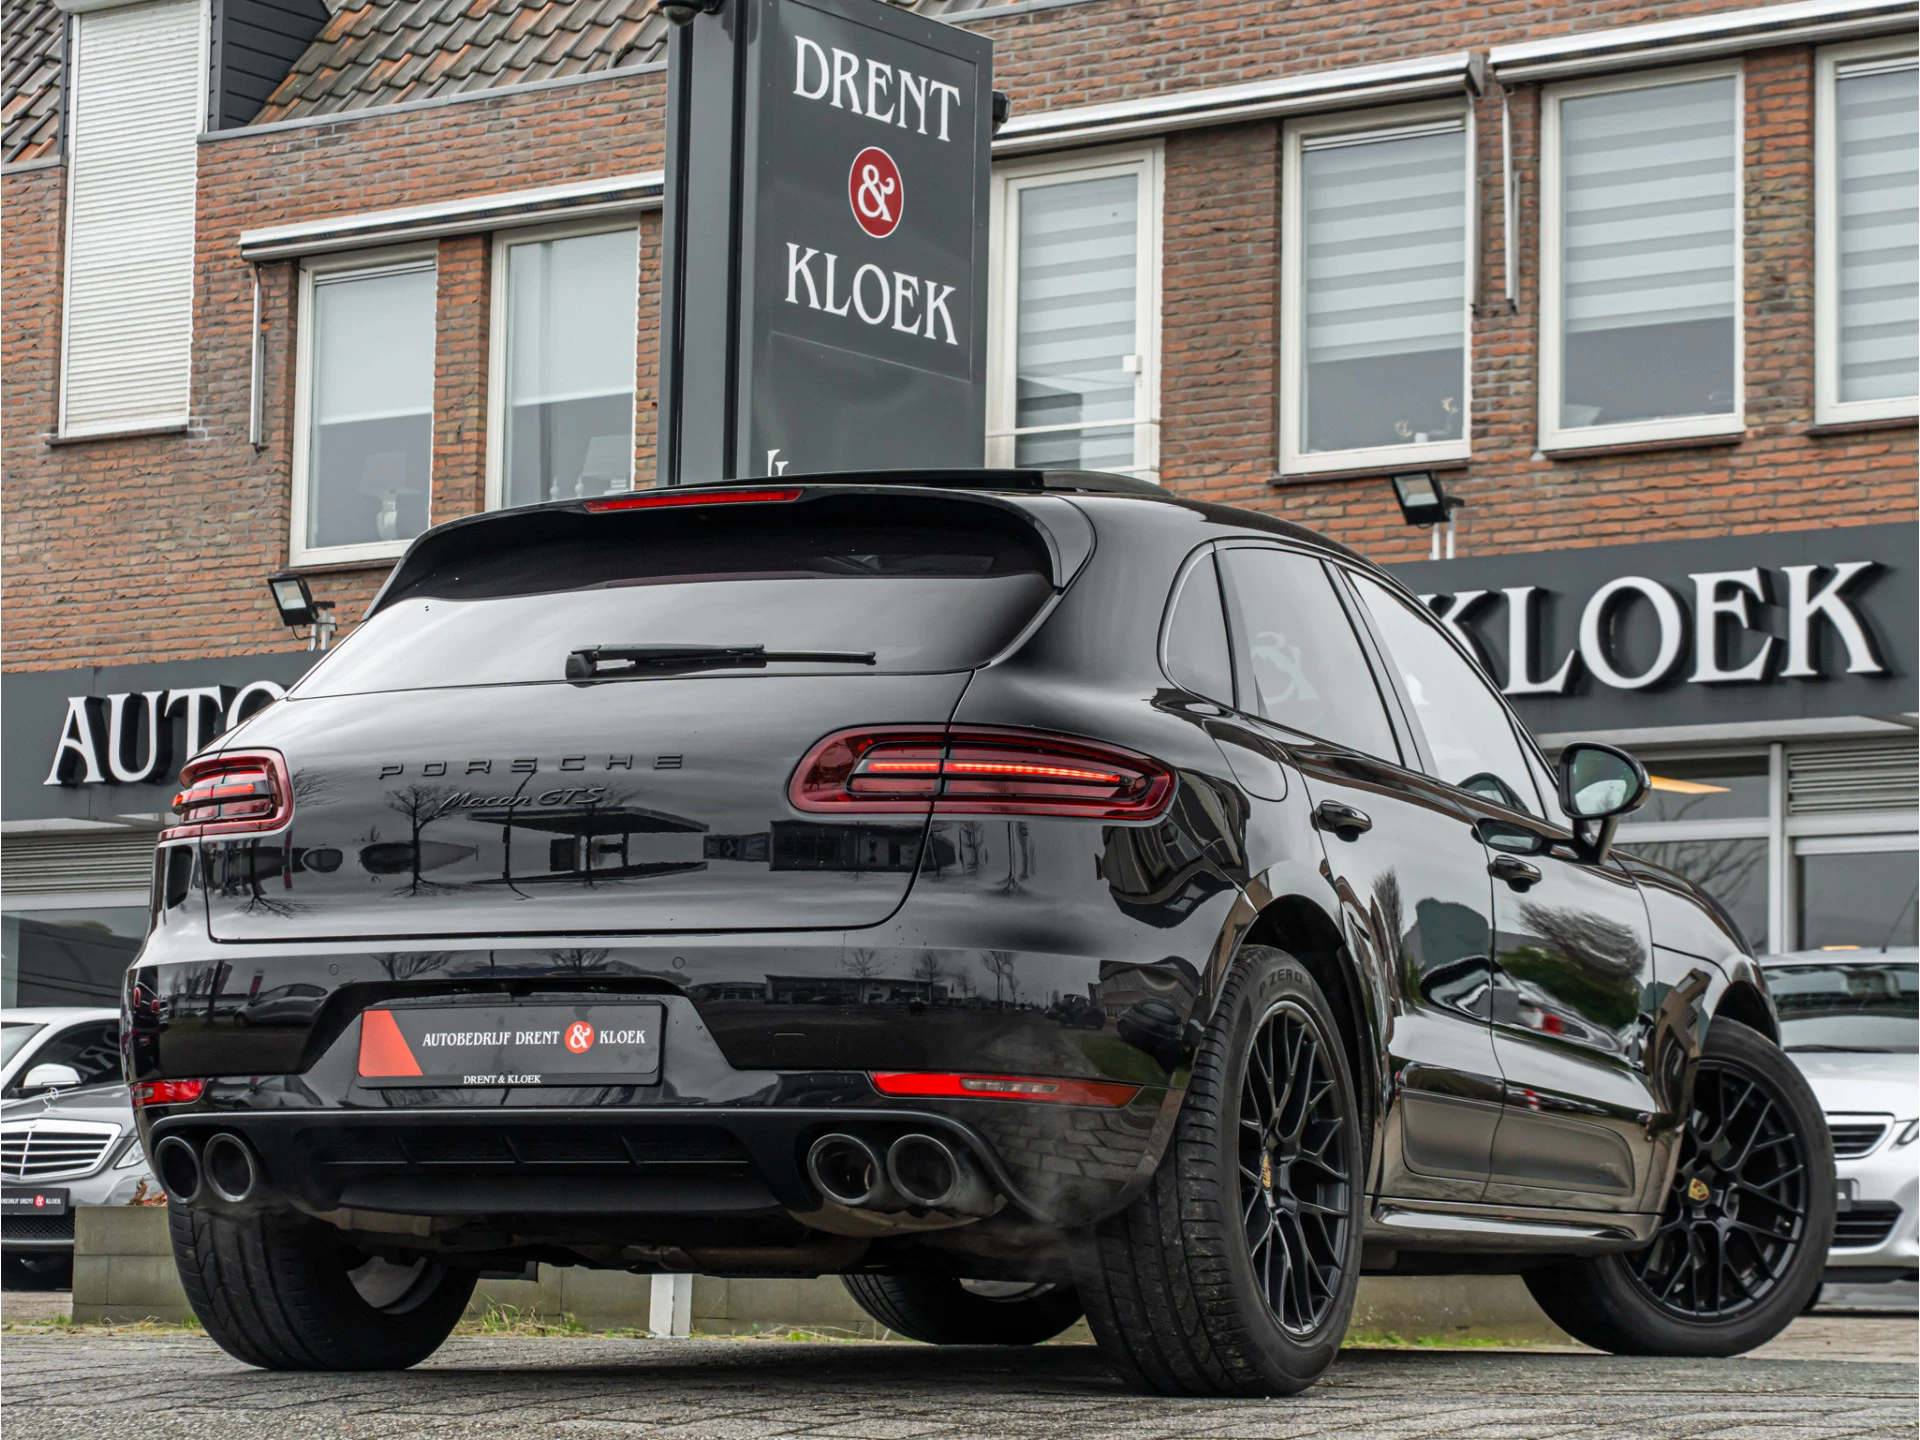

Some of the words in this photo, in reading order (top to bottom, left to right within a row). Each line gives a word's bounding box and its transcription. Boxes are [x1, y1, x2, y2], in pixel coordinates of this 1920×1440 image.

[793, 35, 960, 142] DRENT
[857, 164, 895, 223] &
[784, 242, 958, 345] KLOEK
[1410, 561, 1884, 700] KLOEK
[378, 753, 683, 779] PORSCHE
[439, 791, 531, 809] Macan
[537, 787, 606, 806] GTS
[1268, 968, 1303, 985] ZERO
[422, 1031, 511, 1047] AUTOBEDRIJF
[515, 1031, 560, 1046] DRENT
[569, 1024, 591, 1049] &
[599, 1030, 646, 1045] KLOEK
[463, 1075, 497, 1085] DRENT
[497, 1075, 506, 1084] &
[507, 1074, 541, 1084] KLOEK
